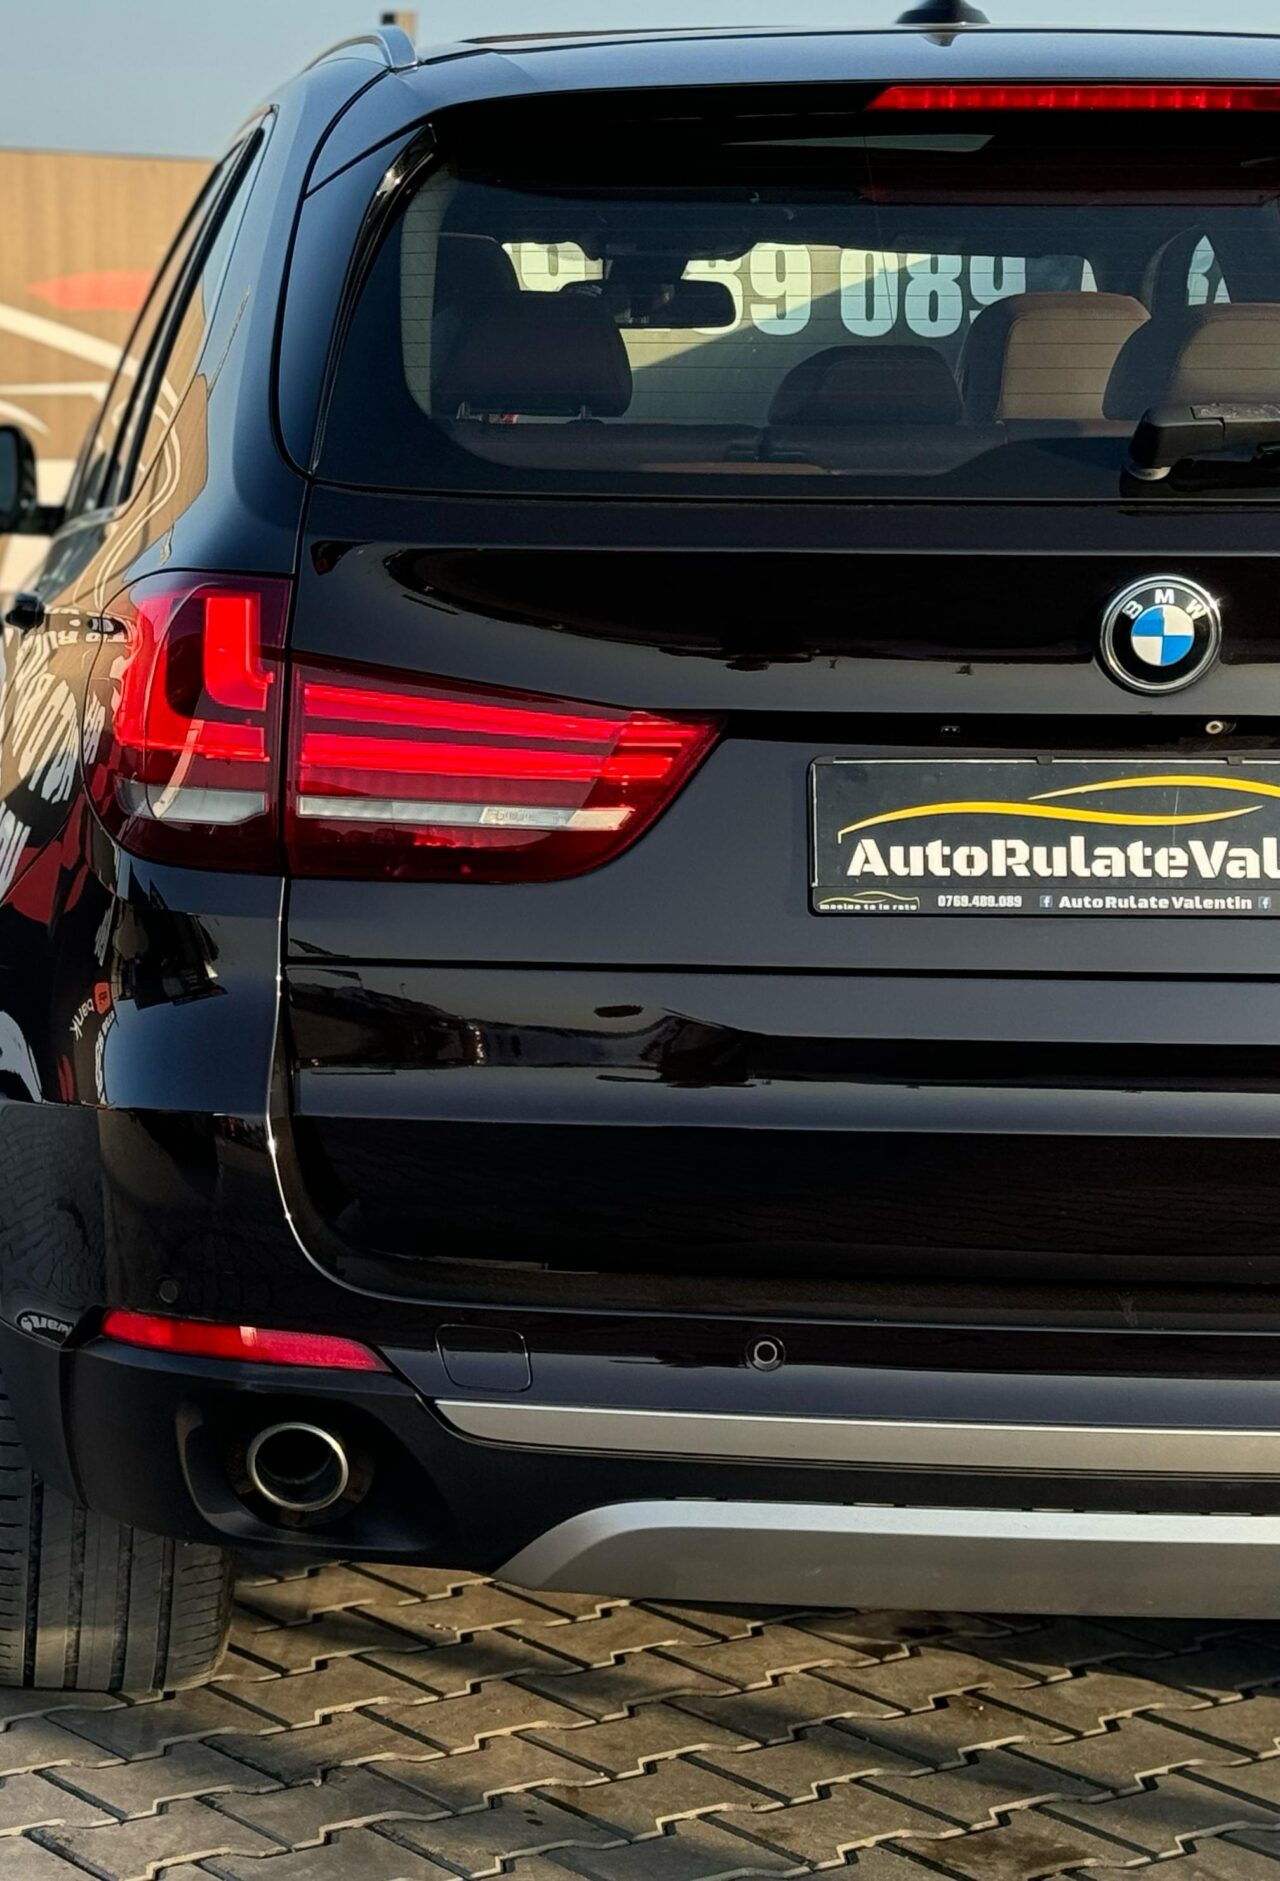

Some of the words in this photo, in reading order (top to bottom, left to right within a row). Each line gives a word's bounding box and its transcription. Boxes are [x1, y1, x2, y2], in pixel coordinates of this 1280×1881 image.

[1122, 588, 1208, 620] BMW
[847, 835, 1280, 879] AutoRulateVal
[1171, 896, 1253, 909] Valentin
